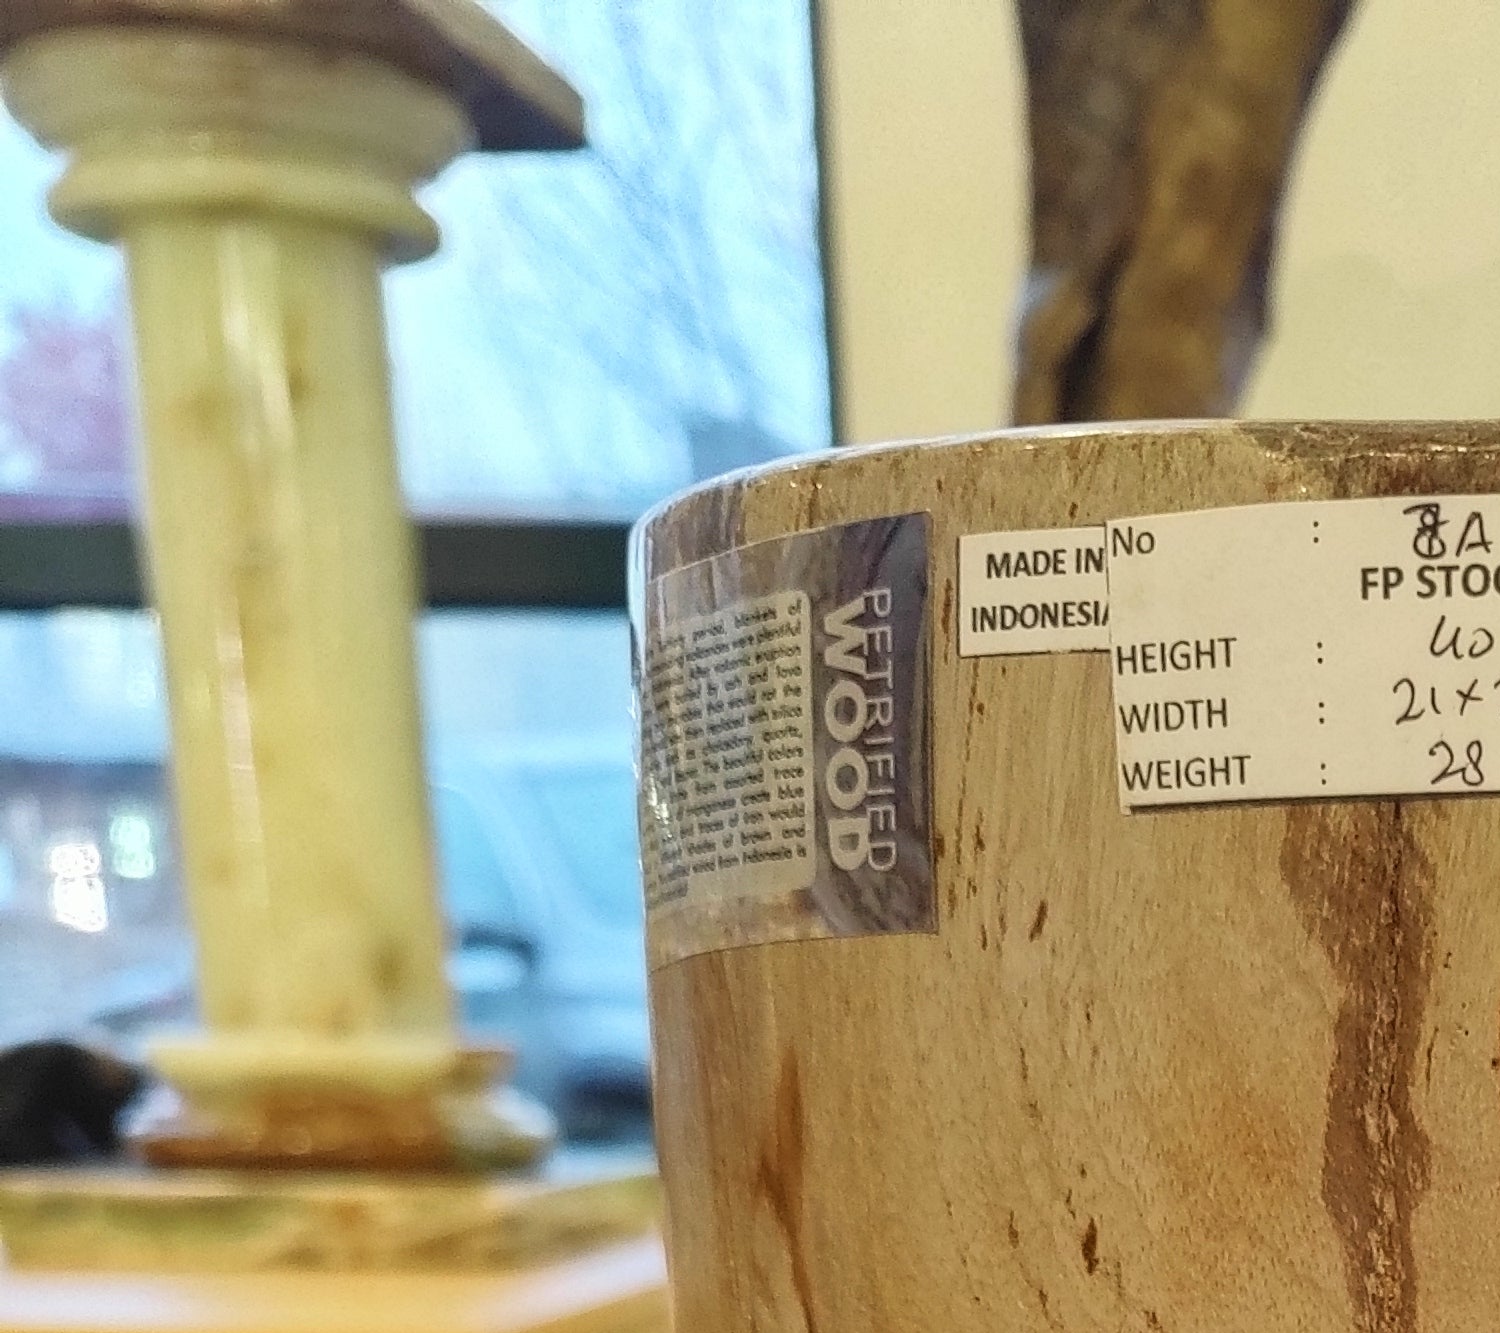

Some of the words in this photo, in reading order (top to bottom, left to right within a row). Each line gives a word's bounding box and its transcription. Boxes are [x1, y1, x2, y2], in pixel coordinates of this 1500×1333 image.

[1113, 526, 1155, 557] No
[986, 549, 1066, 579] MADE
[1076, 547, 1104, 574] IN
[1361, 566, 1404, 600] FP
[1116, 637, 1237, 675] HEIGHT
[824, 597, 871, 871] WOOD
[864, 588, 896, 872] PETRIFIED
[1119, 698, 1228, 734] WIDTH
[1121, 755, 1252, 791] WEIGHT
[1428, 739, 1484, 786] 28
